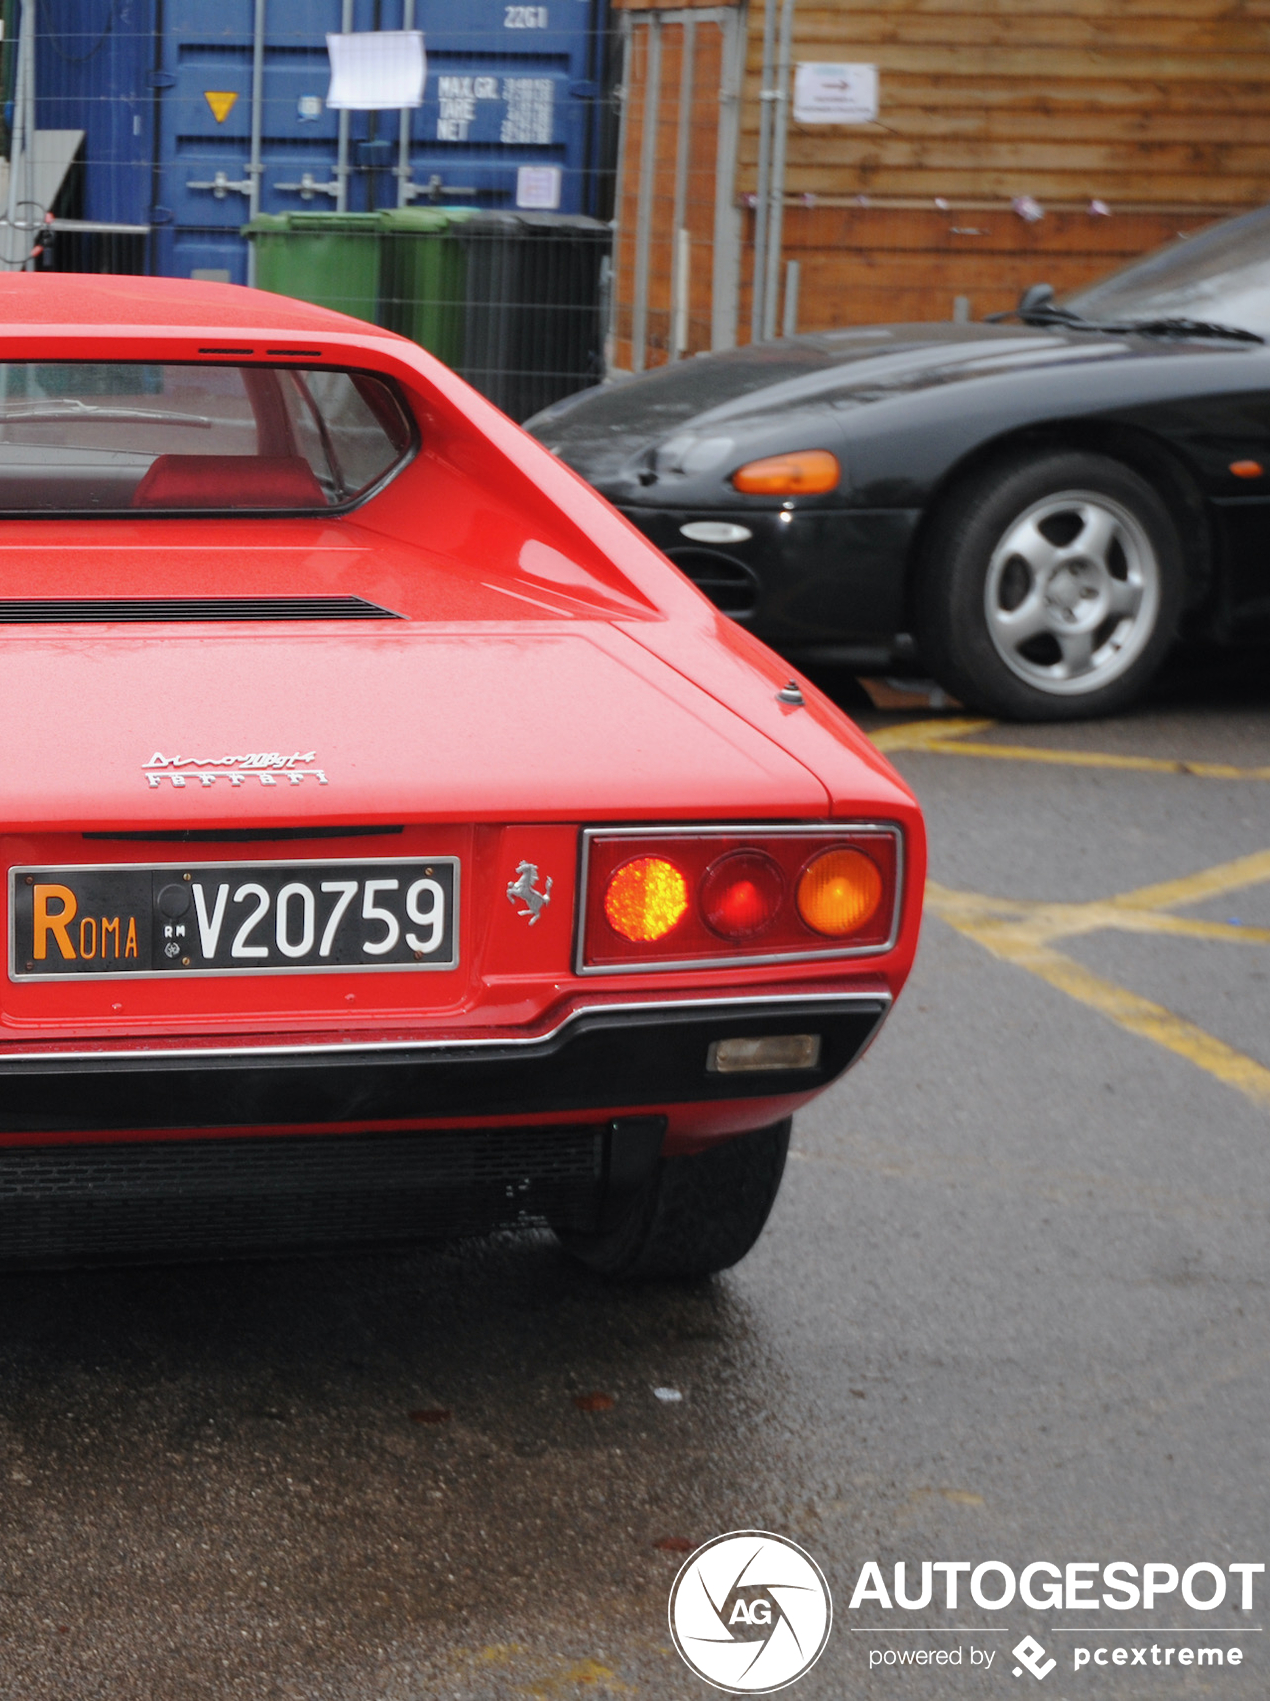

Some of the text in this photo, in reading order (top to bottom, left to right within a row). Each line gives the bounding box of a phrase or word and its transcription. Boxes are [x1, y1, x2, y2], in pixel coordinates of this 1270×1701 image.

[438, 98, 476, 120] TARE
[436, 119, 470, 141] NET
[145, 770, 329, 788] Ferrari
[191, 878, 445, 960] V20759
